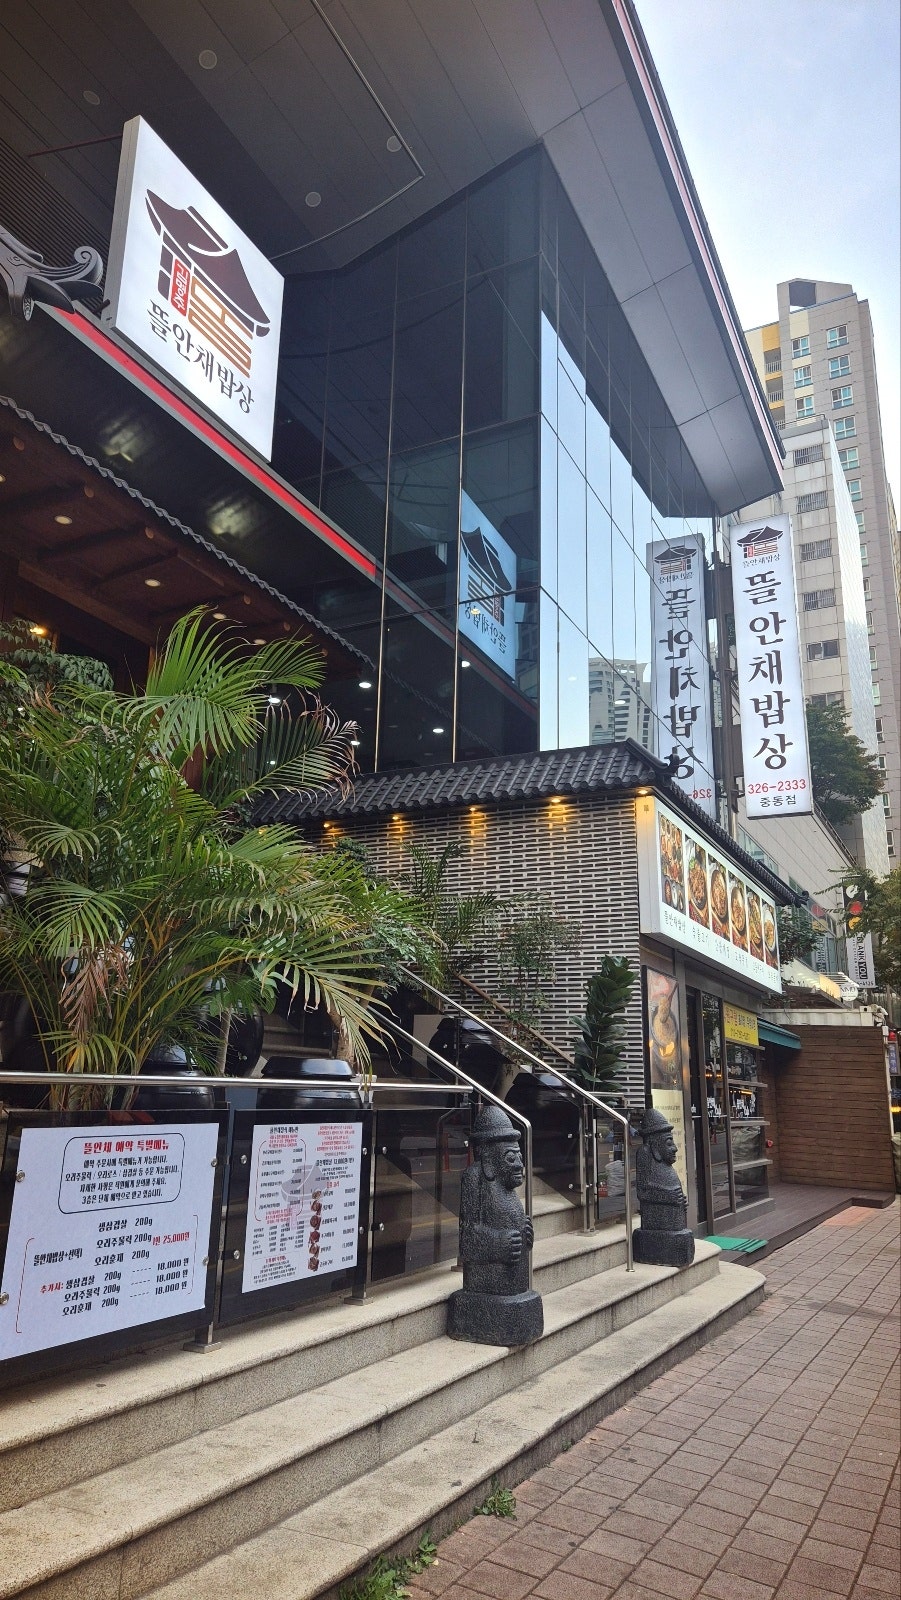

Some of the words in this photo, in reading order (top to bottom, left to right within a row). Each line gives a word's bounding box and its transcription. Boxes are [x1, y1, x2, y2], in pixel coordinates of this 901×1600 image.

[147, 299, 255, 413] 뜰안채밥상
[743, 571, 794, 770] 뜰안채밥상
[747, 778, 807, 795] 326-2333
[759, 795, 797, 808] 중동점
[858, 961, 868, 980] YOU
[116, 1140, 134, 1152] 예약
[137, 1139, 169, 1151] 특별메뉴
[83, 1159, 95, 1168] 예약
[118, 1156, 142, 1167] 특별메뉴가
[122, 1169, 137, 1178] 삼겹살
[145, 1168, 154, 1176] 주문
[80, 1182, 96, 1193] 자세한
[98, 1181, 113, 1191] 사항은
[115, 1179, 135, 1190] 직원에게
[152, 1176, 167, 1185] 주세요.
[82, 1195, 97, 1205] 3층은
[111, 1191, 131, 1202] 예약으로
[131, 1190, 141, 1199] 받고
[97, 1219, 127, 1232] 생삼겹살
[135, 1216, 153, 1227] 200g
[96, 1234, 132, 1249] 오리주물럭
[134, 1233, 152, 1243] 200g
[94, 1252, 124, 1267] 오리훈제
[131, 1249, 150, 1260] 200g
[65, 1274, 95, 1290] 생삼겹살
[104, 1270, 122, 1281] 200g
[183, 1257, 189, 1266] 원
[63, 1286, 100, 1303] 오리주물럭
[103, 1283, 121, 1294] 200g
[182, 1268, 188, 1278] 원
[61, 1301, 92, 1316] 오리훈제
[101, 1297, 119, 1308] 200g
[181, 1280, 187, 1290] 원
